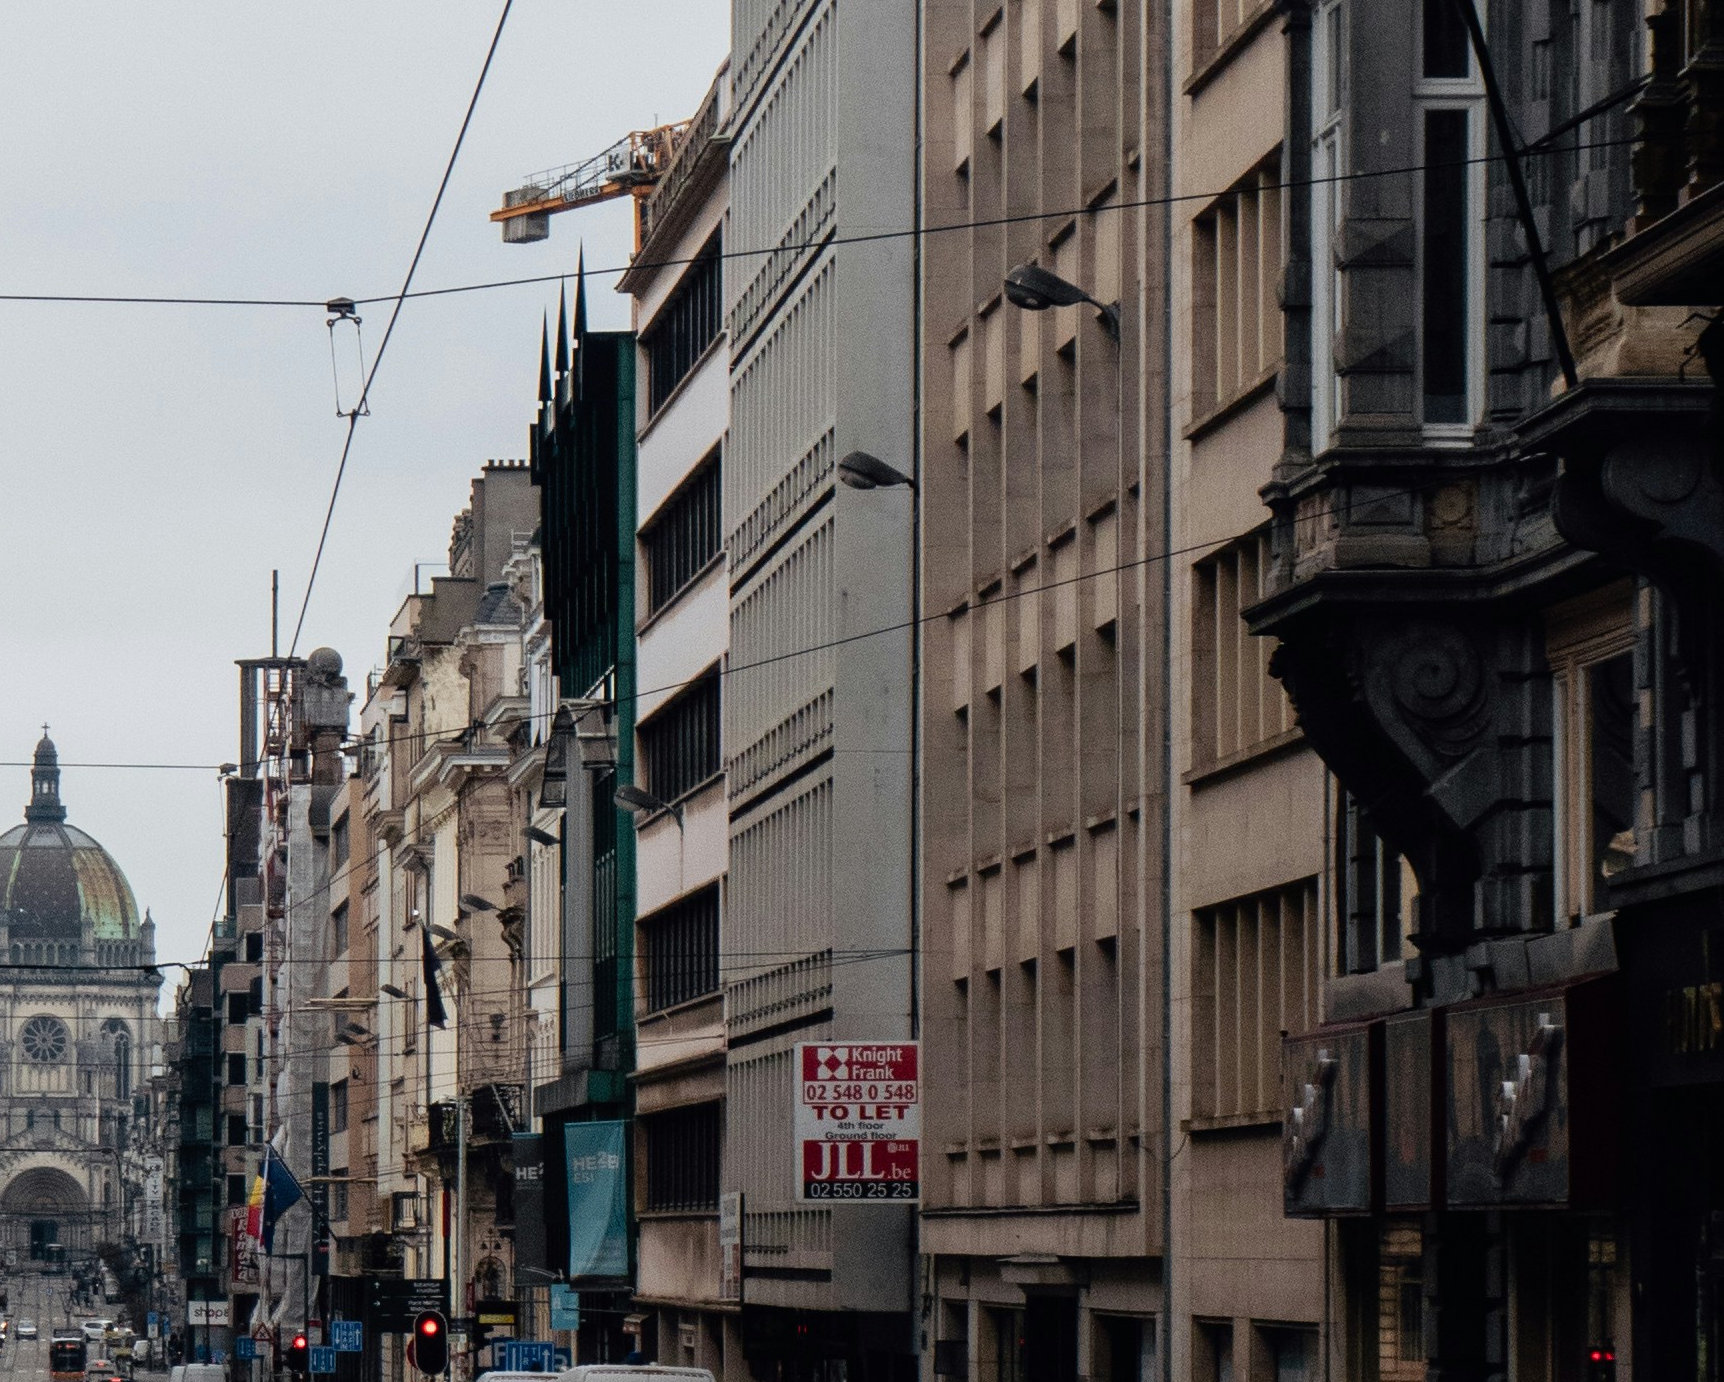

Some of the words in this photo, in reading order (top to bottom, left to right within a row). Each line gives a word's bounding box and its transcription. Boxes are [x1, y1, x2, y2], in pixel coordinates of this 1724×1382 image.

[852, 1047, 903, 1066] Knight
[852, 1065, 895, 1080] Frank
[806, 1084, 828, 1101] 02
[832, 1084, 863, 1101] 548
[868, 1084, 879, 1101] 0
[883, 1084, 915, 1101] 548
[812, 1105, 850, 1120] TO
[859, 1105, 910, 1120] LET
[858, 1122, 885, 1130] floor
[825, 1131, 868, 1140] Ground
[810, 1183, 831, 1198] 02
[833, 1183, 863, 1198] 550
[867, 1183, 887, 1198] 25
[892, 1183, 912, 1198] 25
